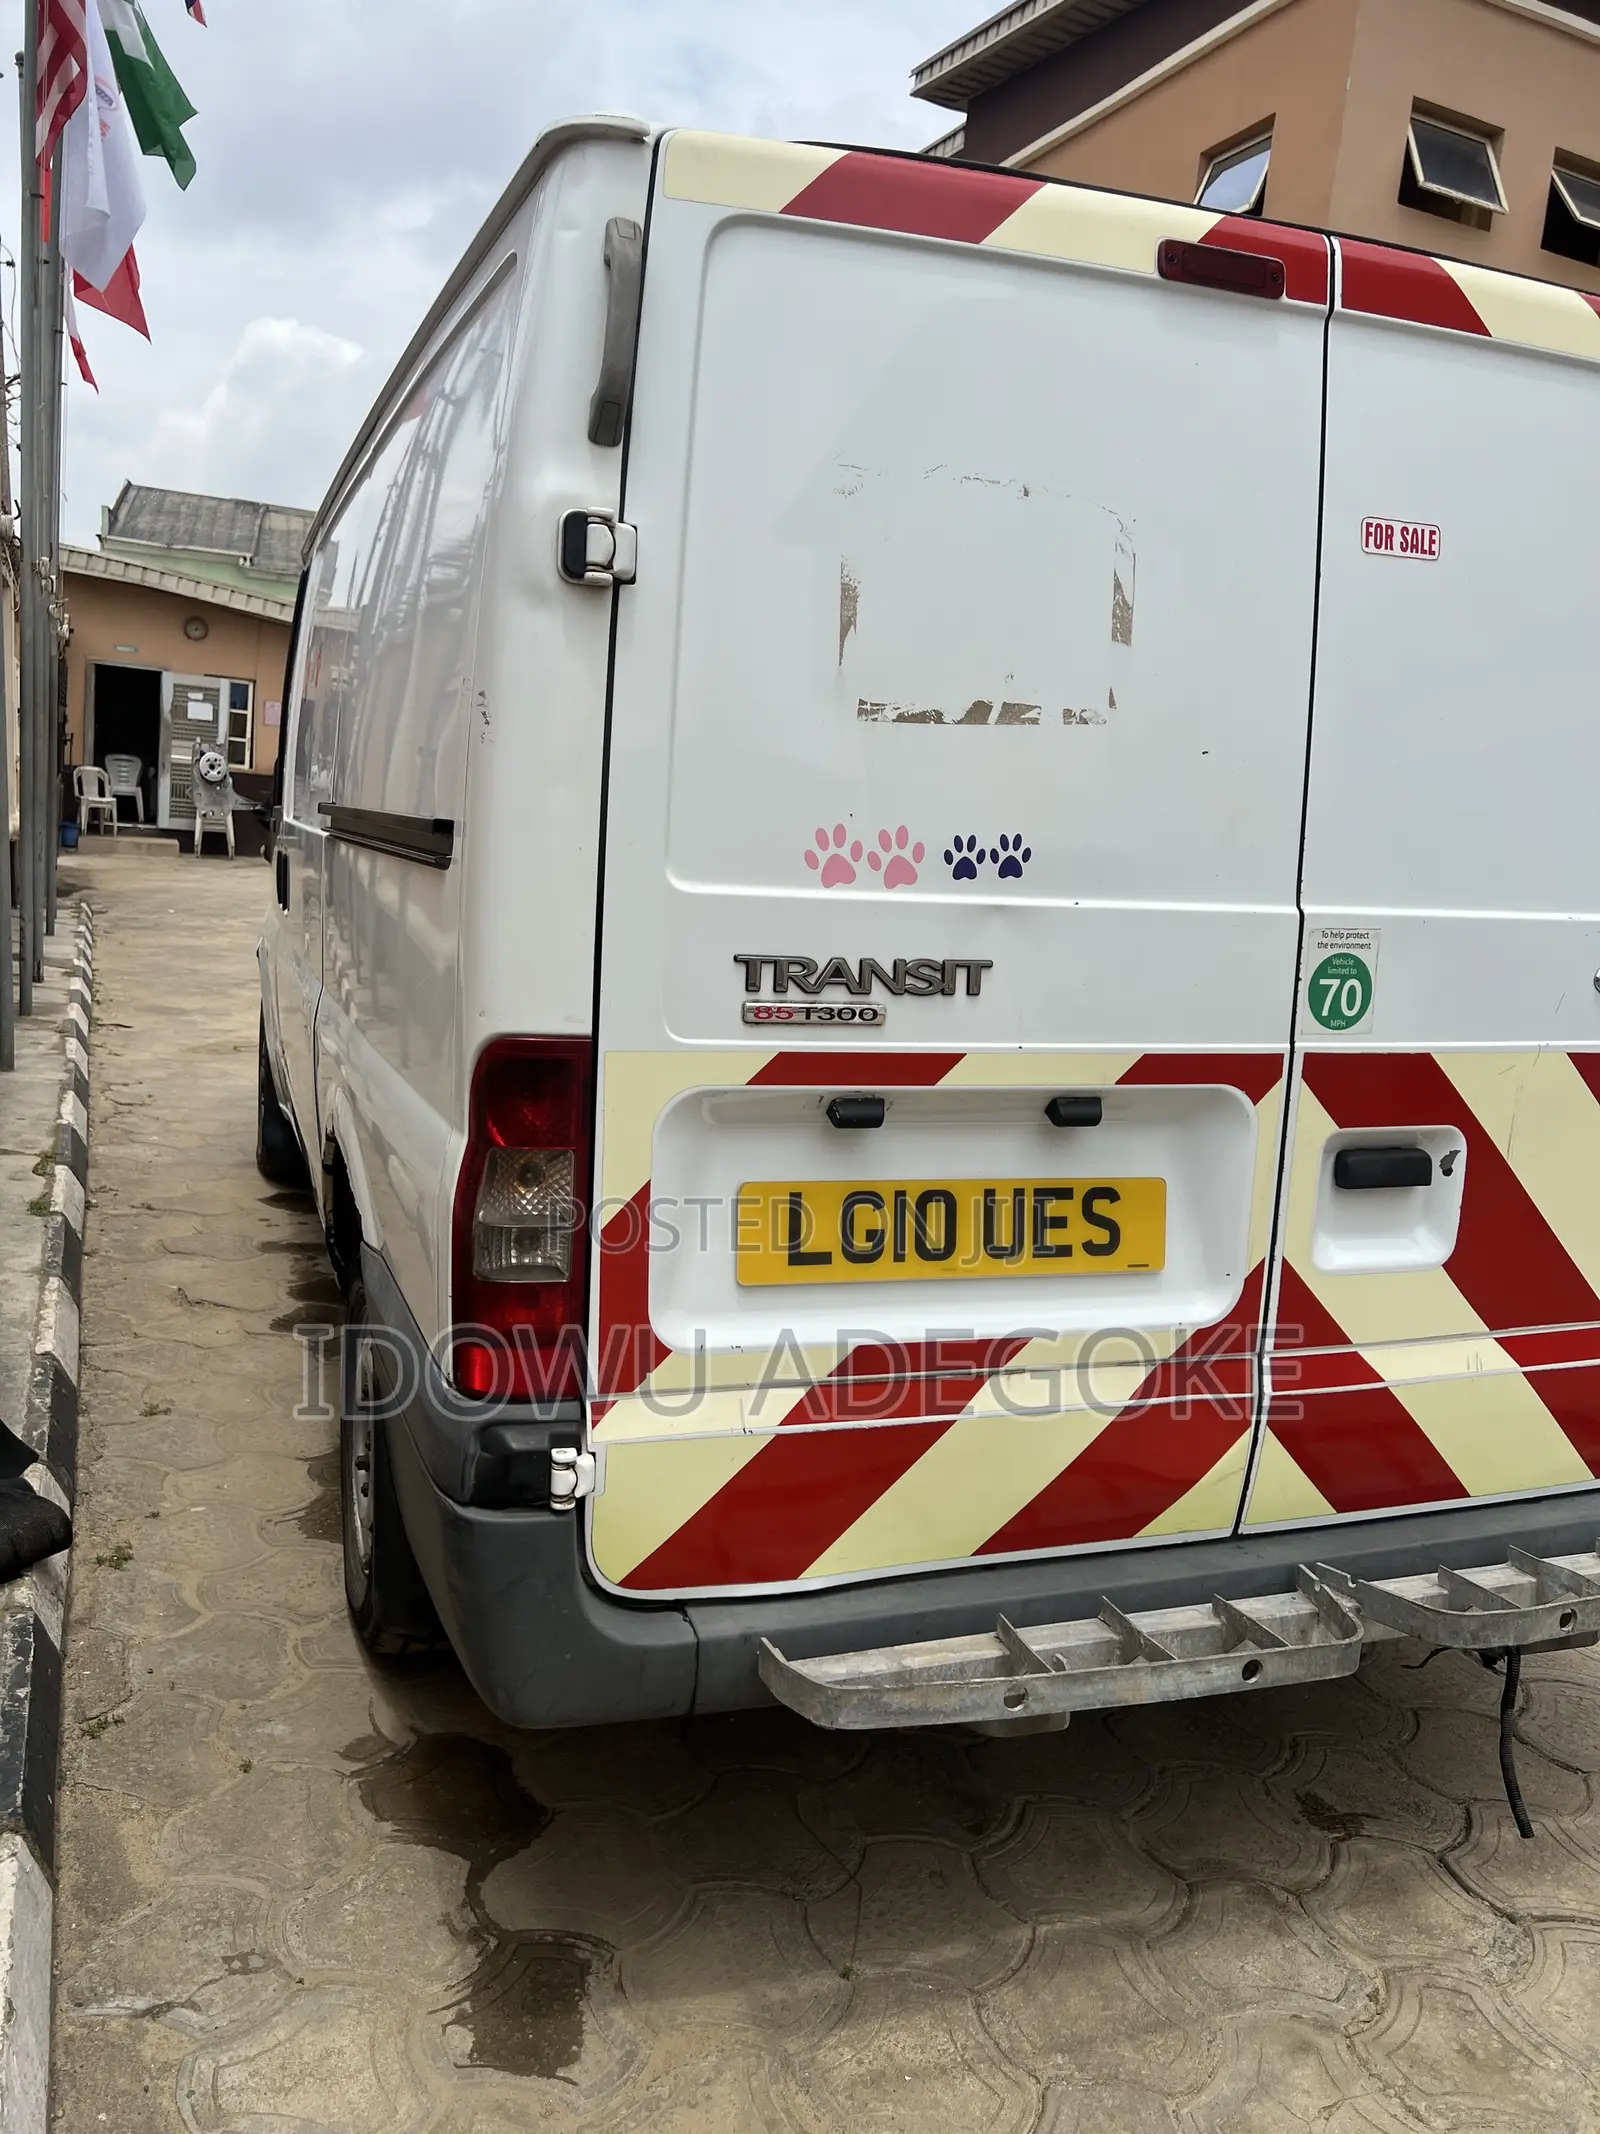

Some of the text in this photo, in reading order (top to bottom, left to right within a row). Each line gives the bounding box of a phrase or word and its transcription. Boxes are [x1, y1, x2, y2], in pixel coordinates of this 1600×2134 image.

[1365, 521, 1436, 556] FOR SALE
[1321, 930, 1370, 941] To help protect
[1317, 941, 1371, 950] the environment
[1332, 957, 1354, 966] Vehicle
[733, 954, 994, 996] TRANSIT
[1327, 966, 1357, 975] limited to
[1319, 978, 1363, 1017] 70
[753, 1004, 879, 1022] 85 T300
[1330, 1019, 1346, 1028] MPH
[983, 1186, 1122, 1260] UES
